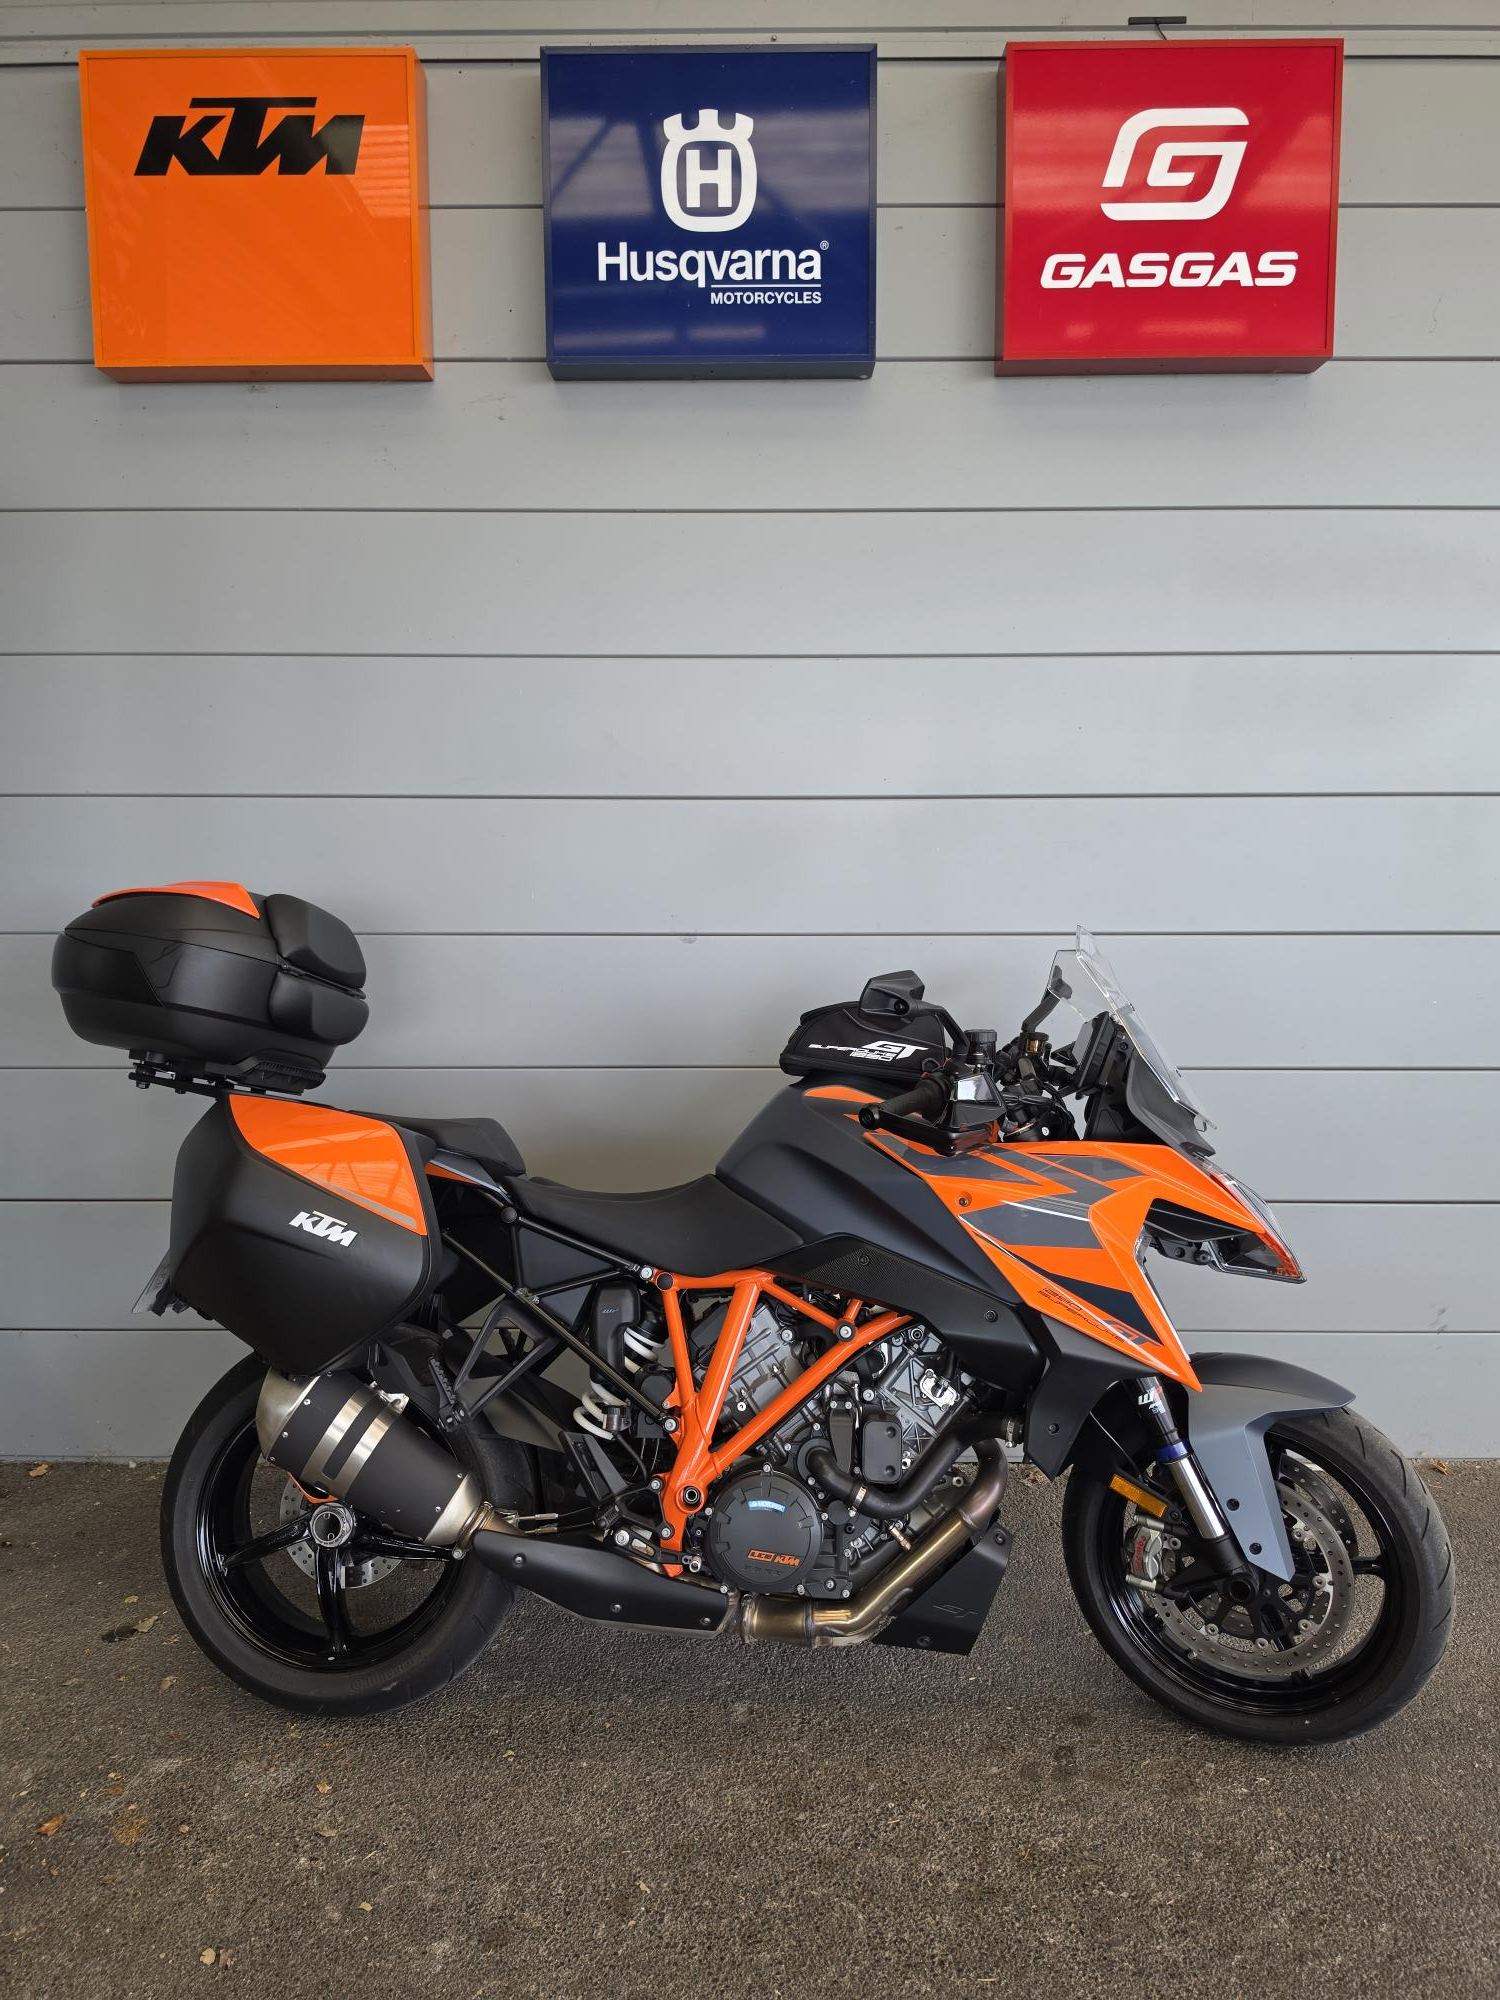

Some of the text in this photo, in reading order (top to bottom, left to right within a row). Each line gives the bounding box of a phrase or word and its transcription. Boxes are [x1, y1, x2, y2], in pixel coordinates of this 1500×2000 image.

[134, 97, 365, 176] KTM
[1040, 251, 1299, 288] GASGAS
[710, 292, 822, 304] MOTORCYCLES
[288, 1210, 359, 1247] KTM
